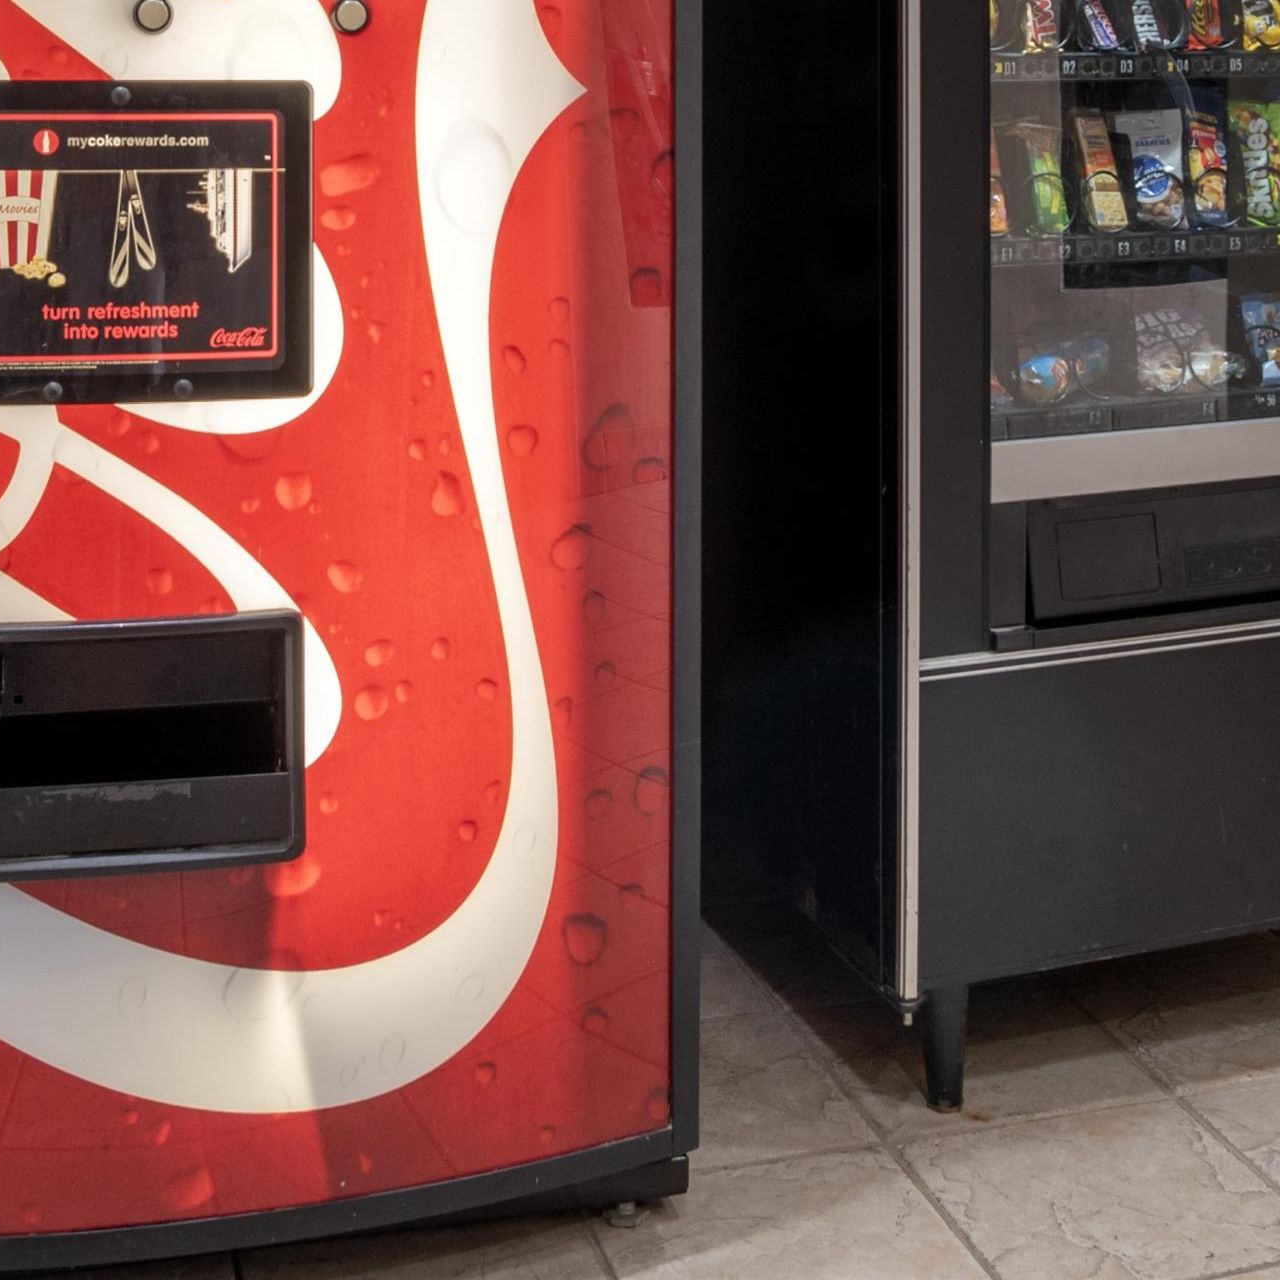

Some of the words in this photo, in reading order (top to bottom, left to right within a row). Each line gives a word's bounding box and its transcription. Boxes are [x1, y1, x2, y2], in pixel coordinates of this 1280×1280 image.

[1004, 62, 1016, 75] D1
[1230, 58, 1242, 72] D5
[67, 133, 210, 149] mycokerewards.com
[1119, 242, 1130, 255] E3
[1174, 240, 1186, 254] E4
[1230, 237, 1241, 250] E5
[42, 304, 80, 321] turn
[88, 301, 200, 320] refreshment
[63, 322, 99, 340] into
[104, 321, 178, 339] rewards
[210, 327, 268, 348] Coca-Cola
